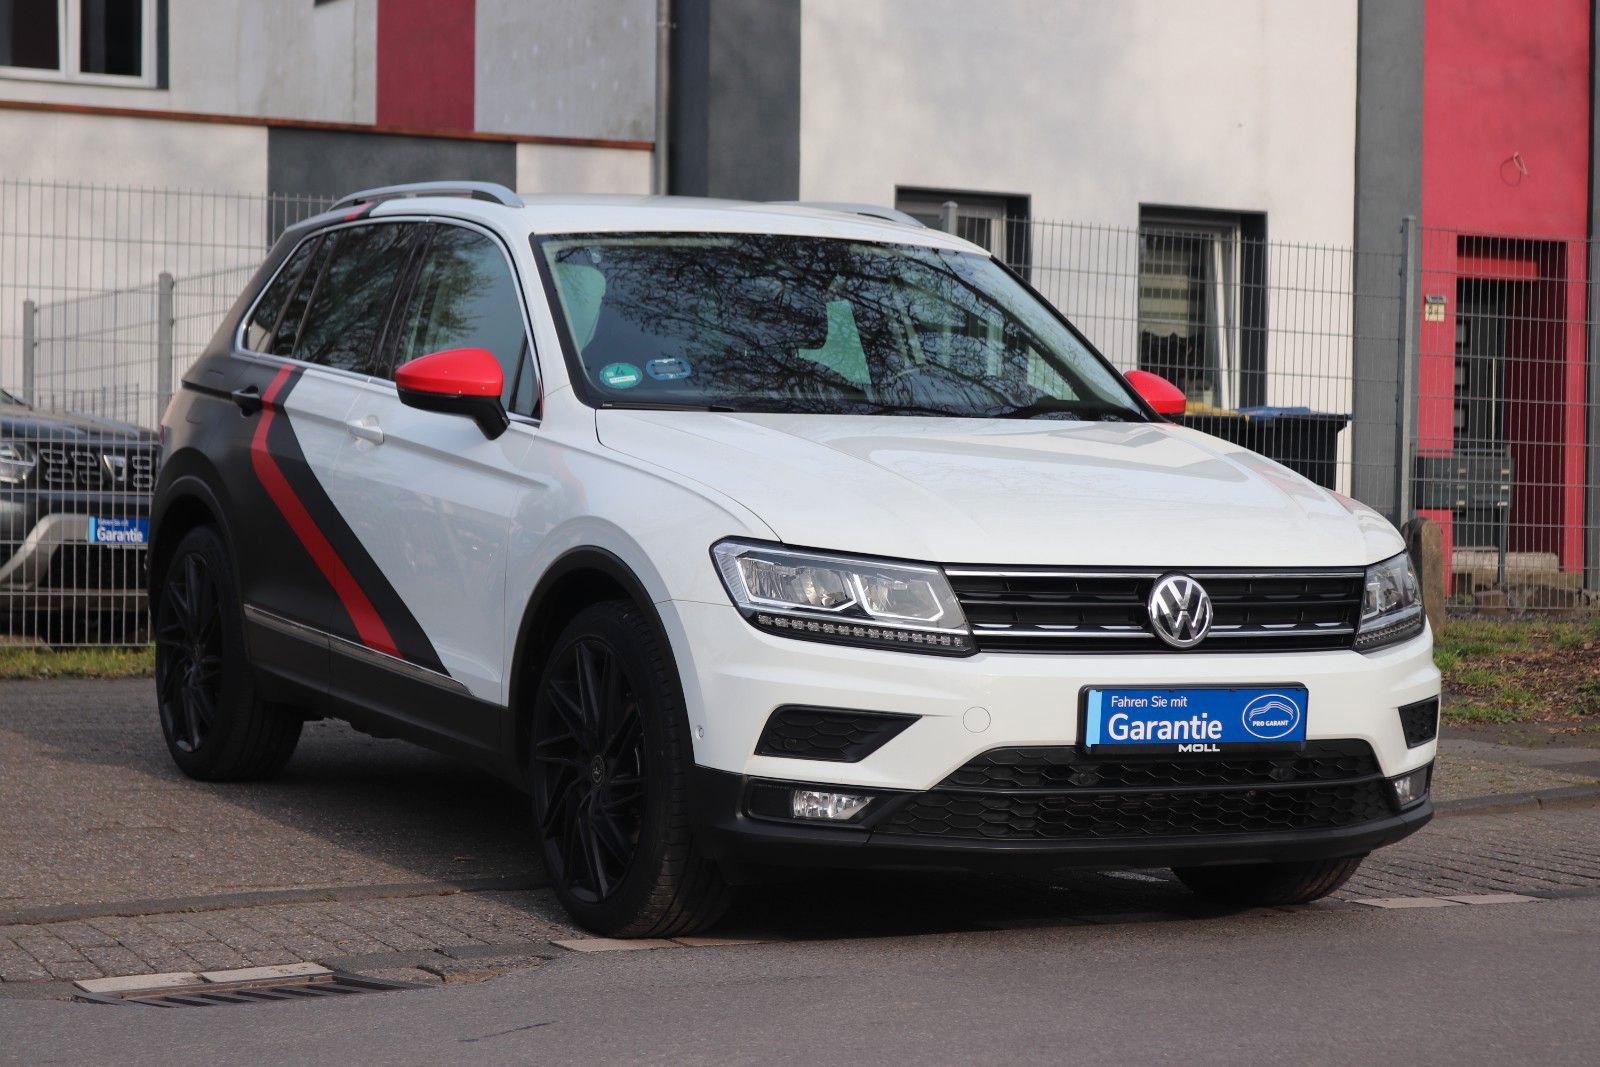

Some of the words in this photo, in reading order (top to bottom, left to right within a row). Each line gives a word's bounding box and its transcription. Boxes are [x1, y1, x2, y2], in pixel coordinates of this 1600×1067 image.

[97, 526, 143, 542] Garantie
[1111, 695, 1148, 708] Fahren
[1151, 696, 1167, 708] Sie
[1170, 696, 1188, 708] mit
[1108, 712, 1223, 741] Garantie
[1178, 743, 1221, 753] MOLL
